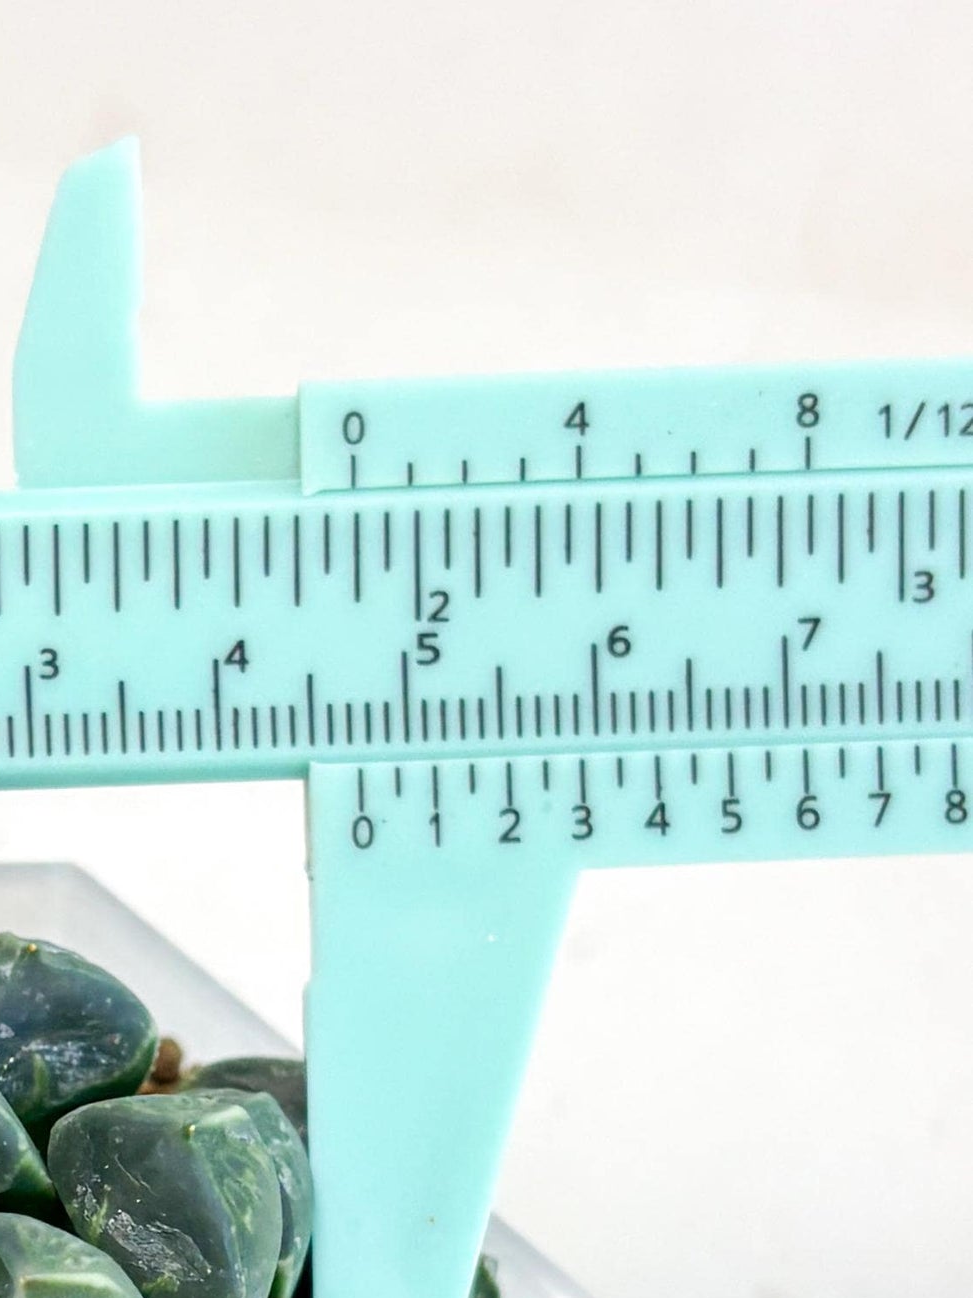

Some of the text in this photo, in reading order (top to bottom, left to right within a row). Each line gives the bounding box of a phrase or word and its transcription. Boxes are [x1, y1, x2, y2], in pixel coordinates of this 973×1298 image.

[342, 410, 366, 446] 0
[564, 401, 590, 436] 4
[796, 392, 820, 429] 8
[427, 590, 450, 623] 2
[913, 570, 936, 604] 3
[39, 647, 60, 681] 3
[224, 639, 250, 674] 4
[416, 632, 441, 666] 5
[606, 624, 632, 658] 6
[797, 616, 822, 651] 7
[351, 787, 969, 850] 0 1 2 3 4 5 6 7 8
